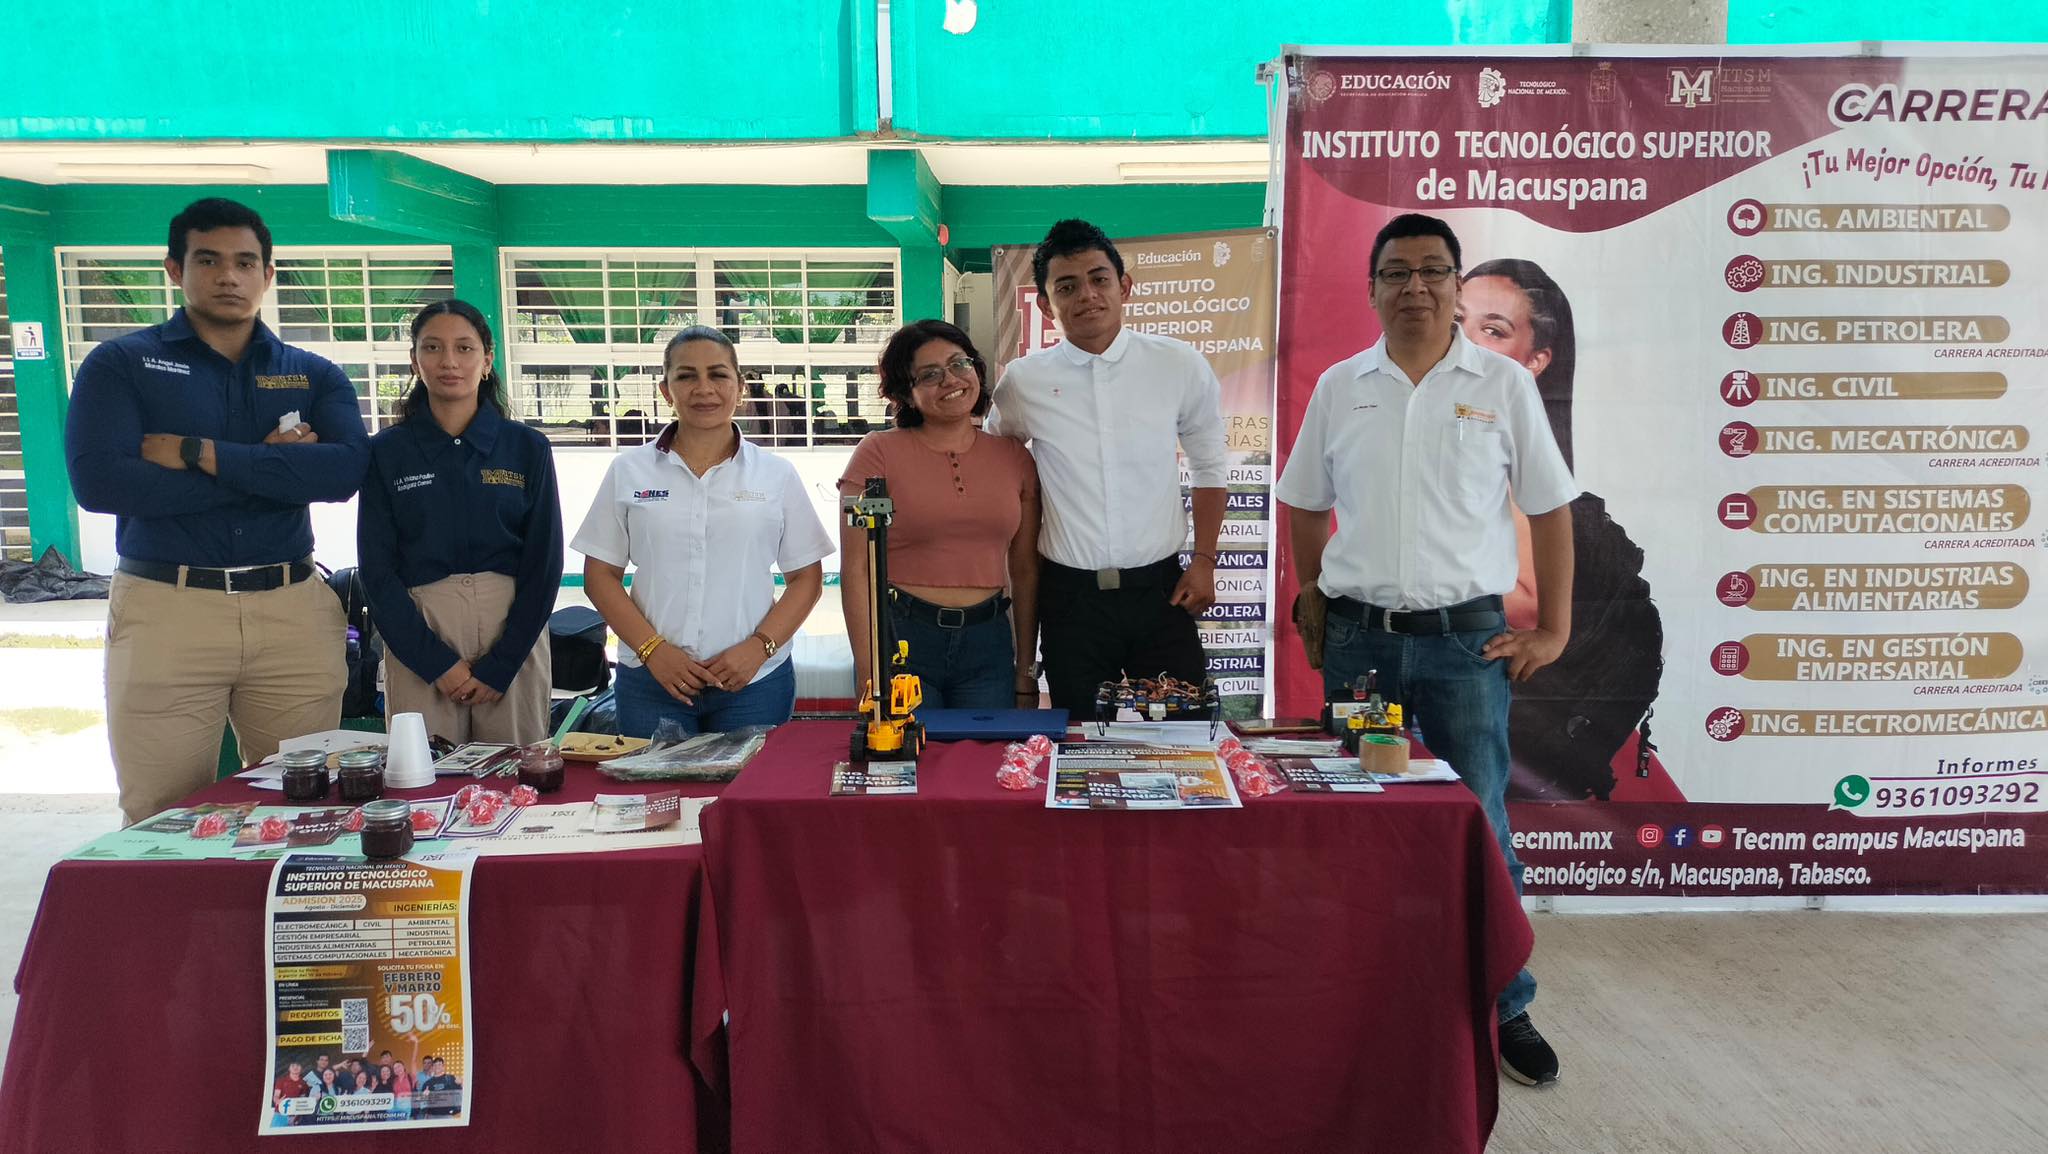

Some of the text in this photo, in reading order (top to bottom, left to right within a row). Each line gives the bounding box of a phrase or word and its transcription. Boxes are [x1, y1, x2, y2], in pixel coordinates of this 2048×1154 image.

[1341, 71, 1452, 90] EDUCACIÓN
[1302, 124, 1772, 160] INSTITUTO TECNOLÓGICO SUPERIOR
[1802, 149, 1839, 189] ¡Tu
[1846, 147, 1910, 182] Mejor
[1915, 152, 1997, 191] Opción,
[2009, 162, 2038, 189] Tu
[1416, 168, 1648, 210] de Macuspana
[1774, 207, 1988, 229] ING. AMBIENTAL
[1137, 249, 1201, 266] Educación
[1771, 264, 1990, 285] ING. INDUSTRIAL
[1130, 278, 1216, 297] NSTITUTO
[1122, 296, 1250, 317] TECNOLÓGICO
[1769, 320, 1982, 342] ING. PETROLERA
[1934, 348, 1983, 358] CARRERA
[1766, 377, 1899, 398] ING. CIVIL
[1765, 425, 2018, 451] ING. MECATRÓNICA
[1928, 457, 2040, 468] CARRERA ACREDITADA
[1777, 488, 2004, 510] ING. EN SISTEMAS
[1764, 512, 2014, 533] COMPUTACIONALES
[1924, 538, 2035, 550] CARRERA ACREDITADA
[1760, 566, 2014, 588] ING. EN INDUSTRIAS
[1792, 590, 1980, 611] ALIMENTARIAS
[1777, 633, 1988, 658] ING. EN GESTIÓN
[1797, 661, 1969, 681] EMPRESARIAL
[1222, 680, 1260, 692] CIVIL
[1913, 685, 1959, 695] CARRERA
[1962, 683, 2023, 694] ACREDITADA
[1751, 707, 2047, 733] ING. ELECTROMECÁNICA
[1937, 757, 2038, 775] Informes
[1876, 781, 2040, 809] 9361093292
[1732, 827, 1806, 851] Tecnm
[1813, 829, 1898, 855] campus
[1904, 826, 2026, 853] Macuspana
[286, 869, 428, 882] INSTITUTO TECNOLÓGICO
[1522, 860, 1871, 891] ecnológico s/n, Macuspana, Tabasco.
[284, 879, 435, 892] SUPERIOR DE MACUSPANA
[339, 895, 363, 904] 2025
[393, 902, 457, 912] INGENIERÍAS:
[276, 922, 348, 930] ELECTROMECÁNICA
[276, 933, 308, 941] GESTIÓN
[276, 949, 452, 961] SISTEMAS COMPUTACIONALES MECATRÓNICA
[277, 943, 321, 951] INDUSTRIAS
[384, 971, 441, 982] FEBRERO
[385, 984, 393, 993] Y
[397, 982, 441, 992] MARZO
[290, 1011, 339, 1019] REQUISITOS
[280, 1033, 342, 1043] PAGO DE FICHA
[340, 1097, 391, 1107] 9361093292
